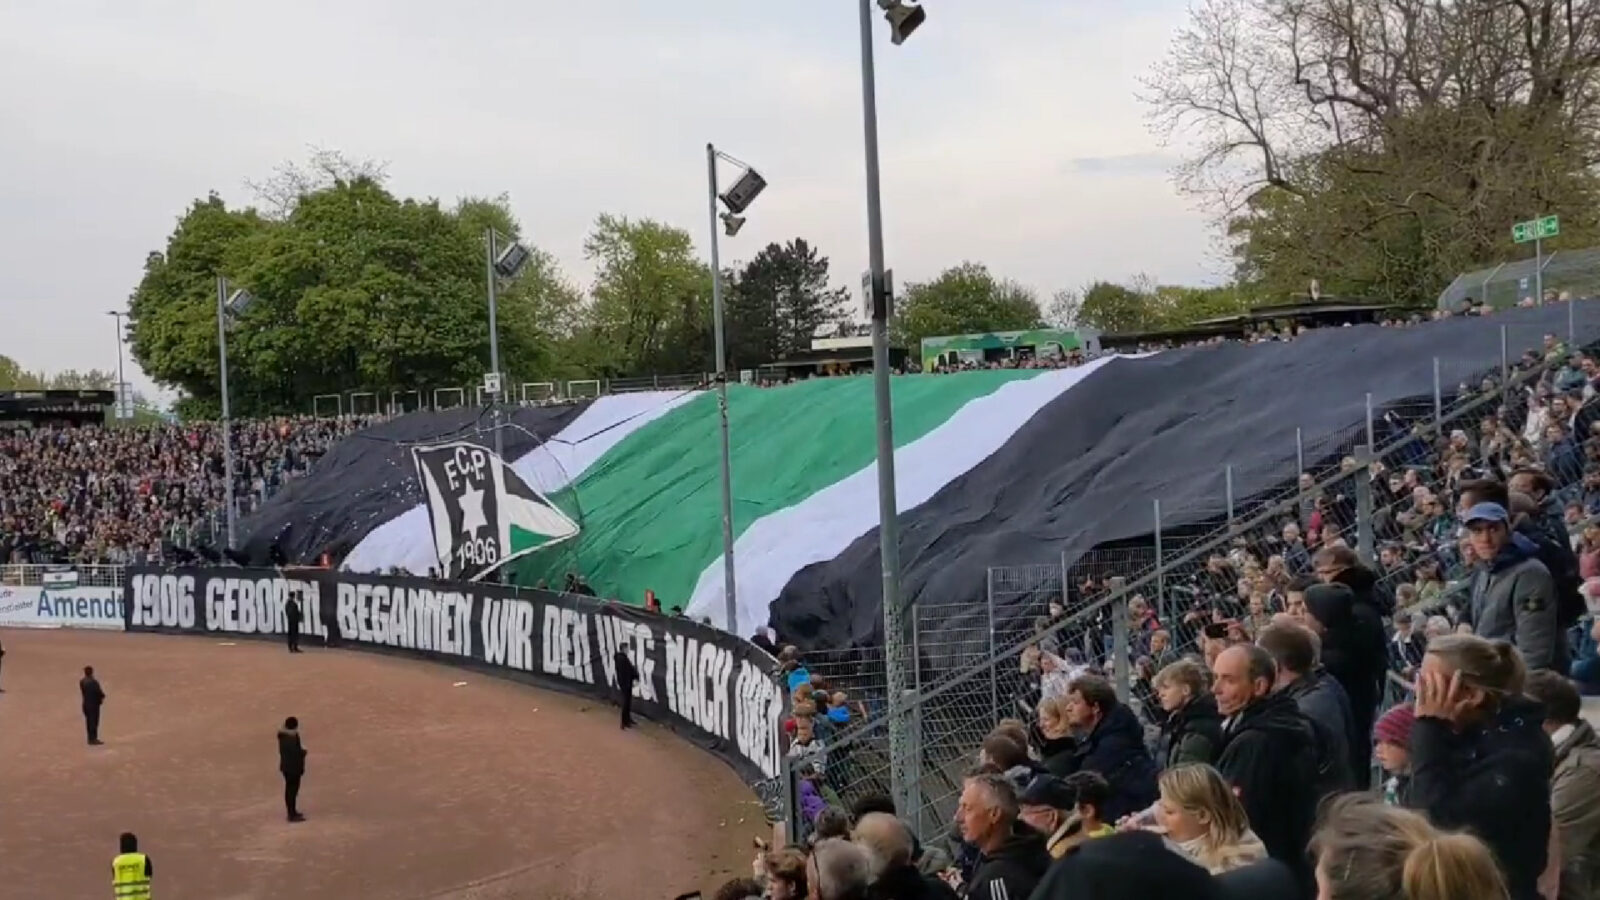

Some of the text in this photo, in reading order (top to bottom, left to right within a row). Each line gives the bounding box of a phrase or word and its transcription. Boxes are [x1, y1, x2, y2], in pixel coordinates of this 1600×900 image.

[456, 536, 496, 569] 1906
[37, 590, 126, 619] Amendt
[132, 573, 195, 628] 1906
[337, 582, 473, 656] BEGANNEN
[481, 597, 533, 670] WIR
[543, 605, 594, 684] DEN
[664, 631, 733, 740] NACH
